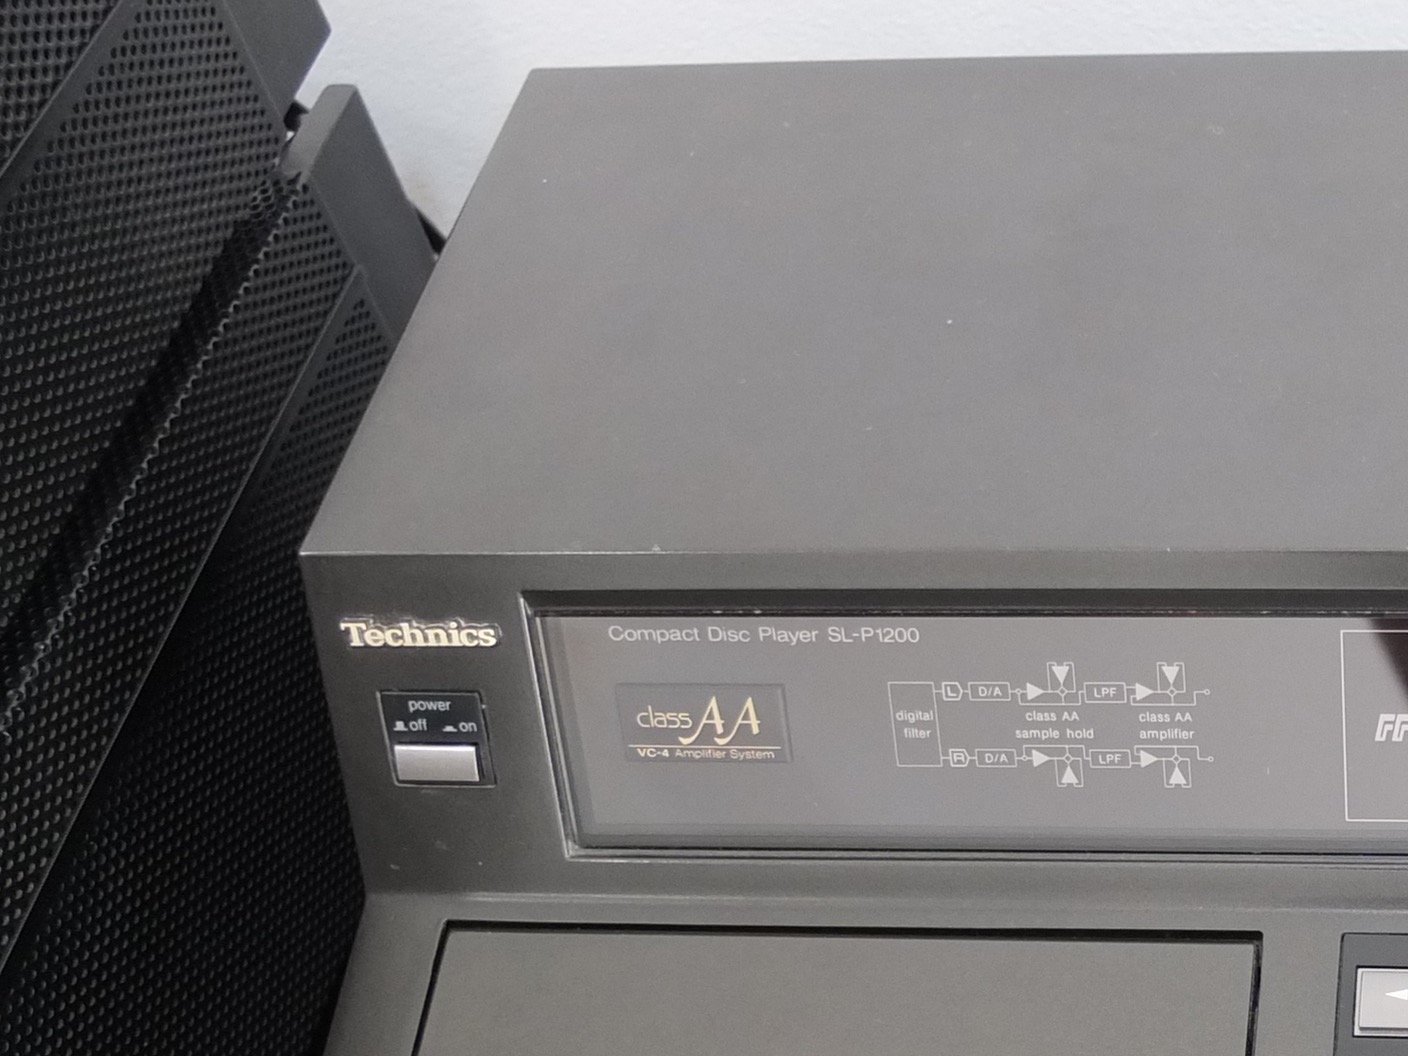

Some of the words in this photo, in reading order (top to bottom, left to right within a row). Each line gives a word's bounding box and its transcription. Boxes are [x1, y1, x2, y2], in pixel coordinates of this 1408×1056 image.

[340, 622, 497, 647] Technics
[608, 626, 700, 643] Compact
[708, 626, 750, 642] Disc
[759, 627, 818, 645] Player
[828, 627, 920, 643] SL-P1200
[979, 687, 1002, 697] D/A
[1094, 688, 1116, 698] LPF
[408, 701, 451, 712] power
[637, 705, 692, 728] class
[678, 696, 760, 745] AA
[896, 711, 934, 723] digital
[1026, 711, 1056, 721] class
[1062, 712, 1080, 721] AA
[1139, 712, 1170, 722] class
[1175, 712, 1192, 722] AA
[410, 719, 427, 731] off
[459, 722, 477, 732] on
[904, 728, 931, 738] filter
[1015, 729, 1059, 741] sample
[1067, 728, 1094, 739] hold
[1139, 729, 1195, 741] amplifier
[637, 748, 669, 758] VC-4
[675, 748, 726, 760] Amplifier
[730, 750, 775, 761] System
[985, 753, 1009, 764] D/A
[1099, 753, 1121, 764] LPF
